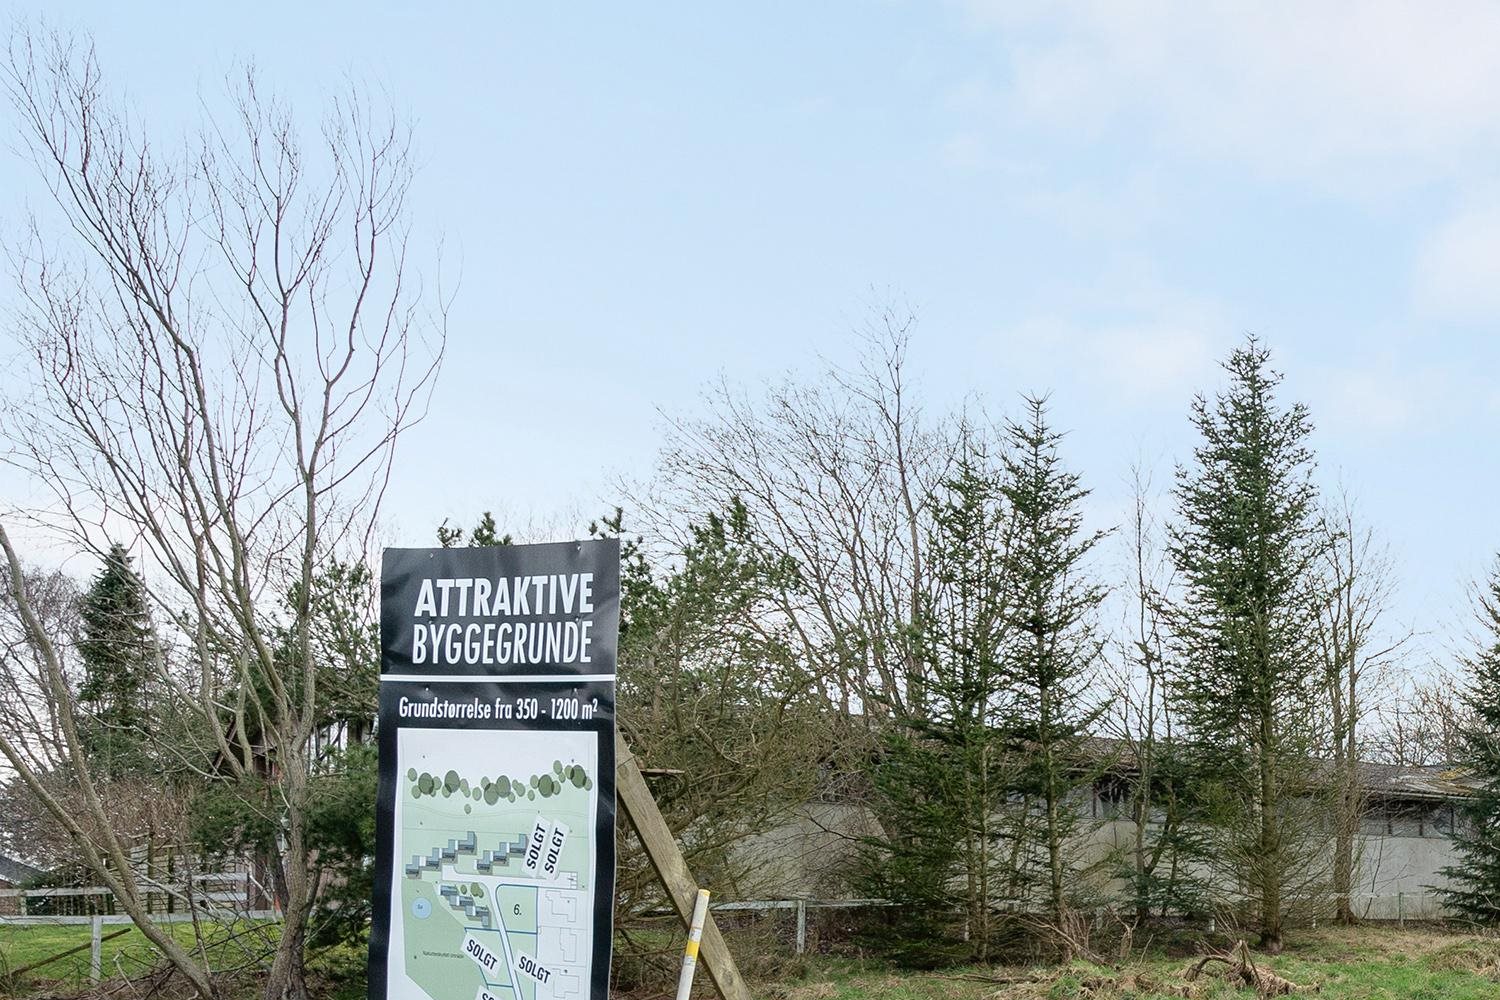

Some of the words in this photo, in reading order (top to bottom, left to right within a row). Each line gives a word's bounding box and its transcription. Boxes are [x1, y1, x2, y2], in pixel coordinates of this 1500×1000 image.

[414, 573, 594, 617] ATTRAKTIVE
[412, 621, 593, 664] BYGGEGRUNDE
[399, 697, 491, 719] Grundstørrelse
[495, 698, 513, 719] fra
[516, 699, 539, 720] 350
[551, 699, 578, 720] 1200
[526, 823, 547, 870] SOLGT
[544, 827, 566, 874] SOLGT
[513, 904, 522, 916] 6.
[466, 939, 498, 970] SOLGT
[518, 956, 551, 985] SOLGT
